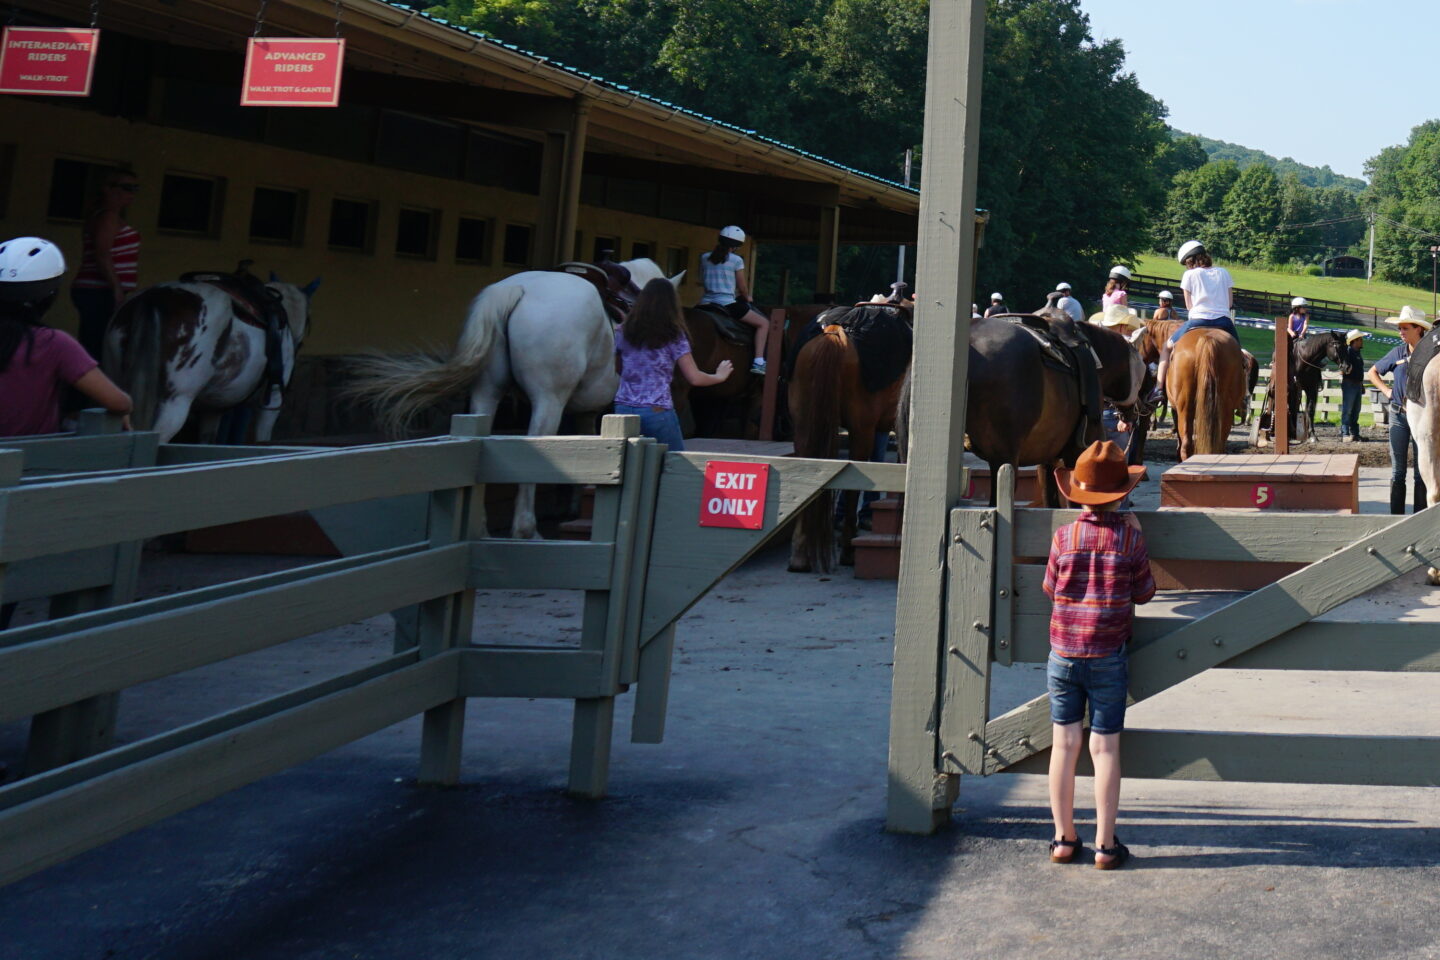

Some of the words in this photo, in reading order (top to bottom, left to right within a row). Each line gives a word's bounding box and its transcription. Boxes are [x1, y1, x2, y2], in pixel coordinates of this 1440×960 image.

[9, 41, 90, 51] INTERMEDIATE
[28, 53, 67, 61] RIDERS
[264, 52, 326, 60] ADVANCED
[275, 64, 313, 72] RIDERS
[715, 472, 757, 490] EXIT
[1256, 486, 1268, 504] 5
[707, 497, 758, 516] ONLY
